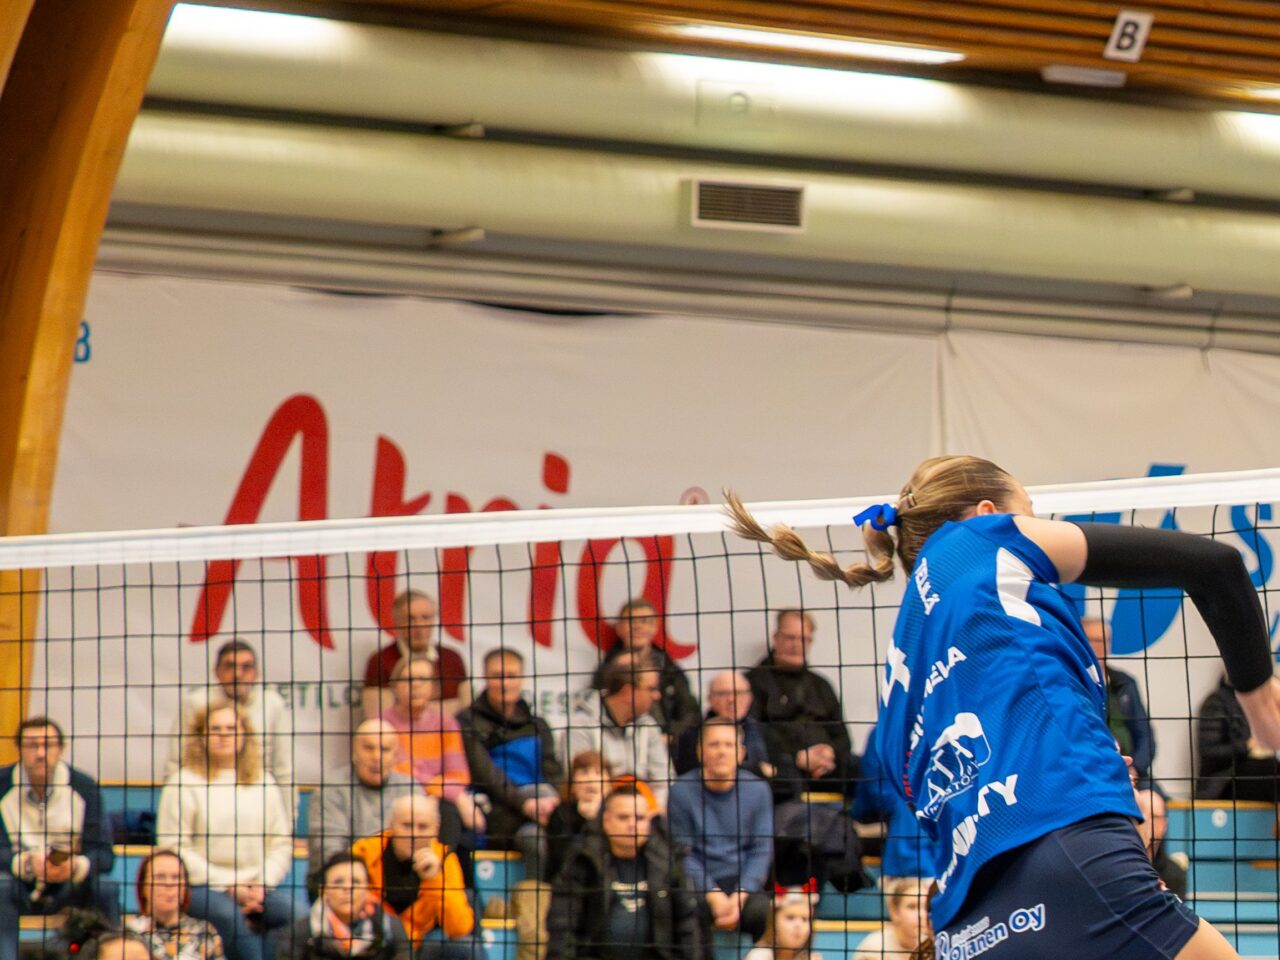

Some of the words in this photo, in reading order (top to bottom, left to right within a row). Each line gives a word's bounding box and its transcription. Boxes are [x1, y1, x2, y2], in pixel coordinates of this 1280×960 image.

[1116, 20, 1140, 51] B
[180, 393, 697, 659] Atria
[1009, 903, 1046, 933] Oy
